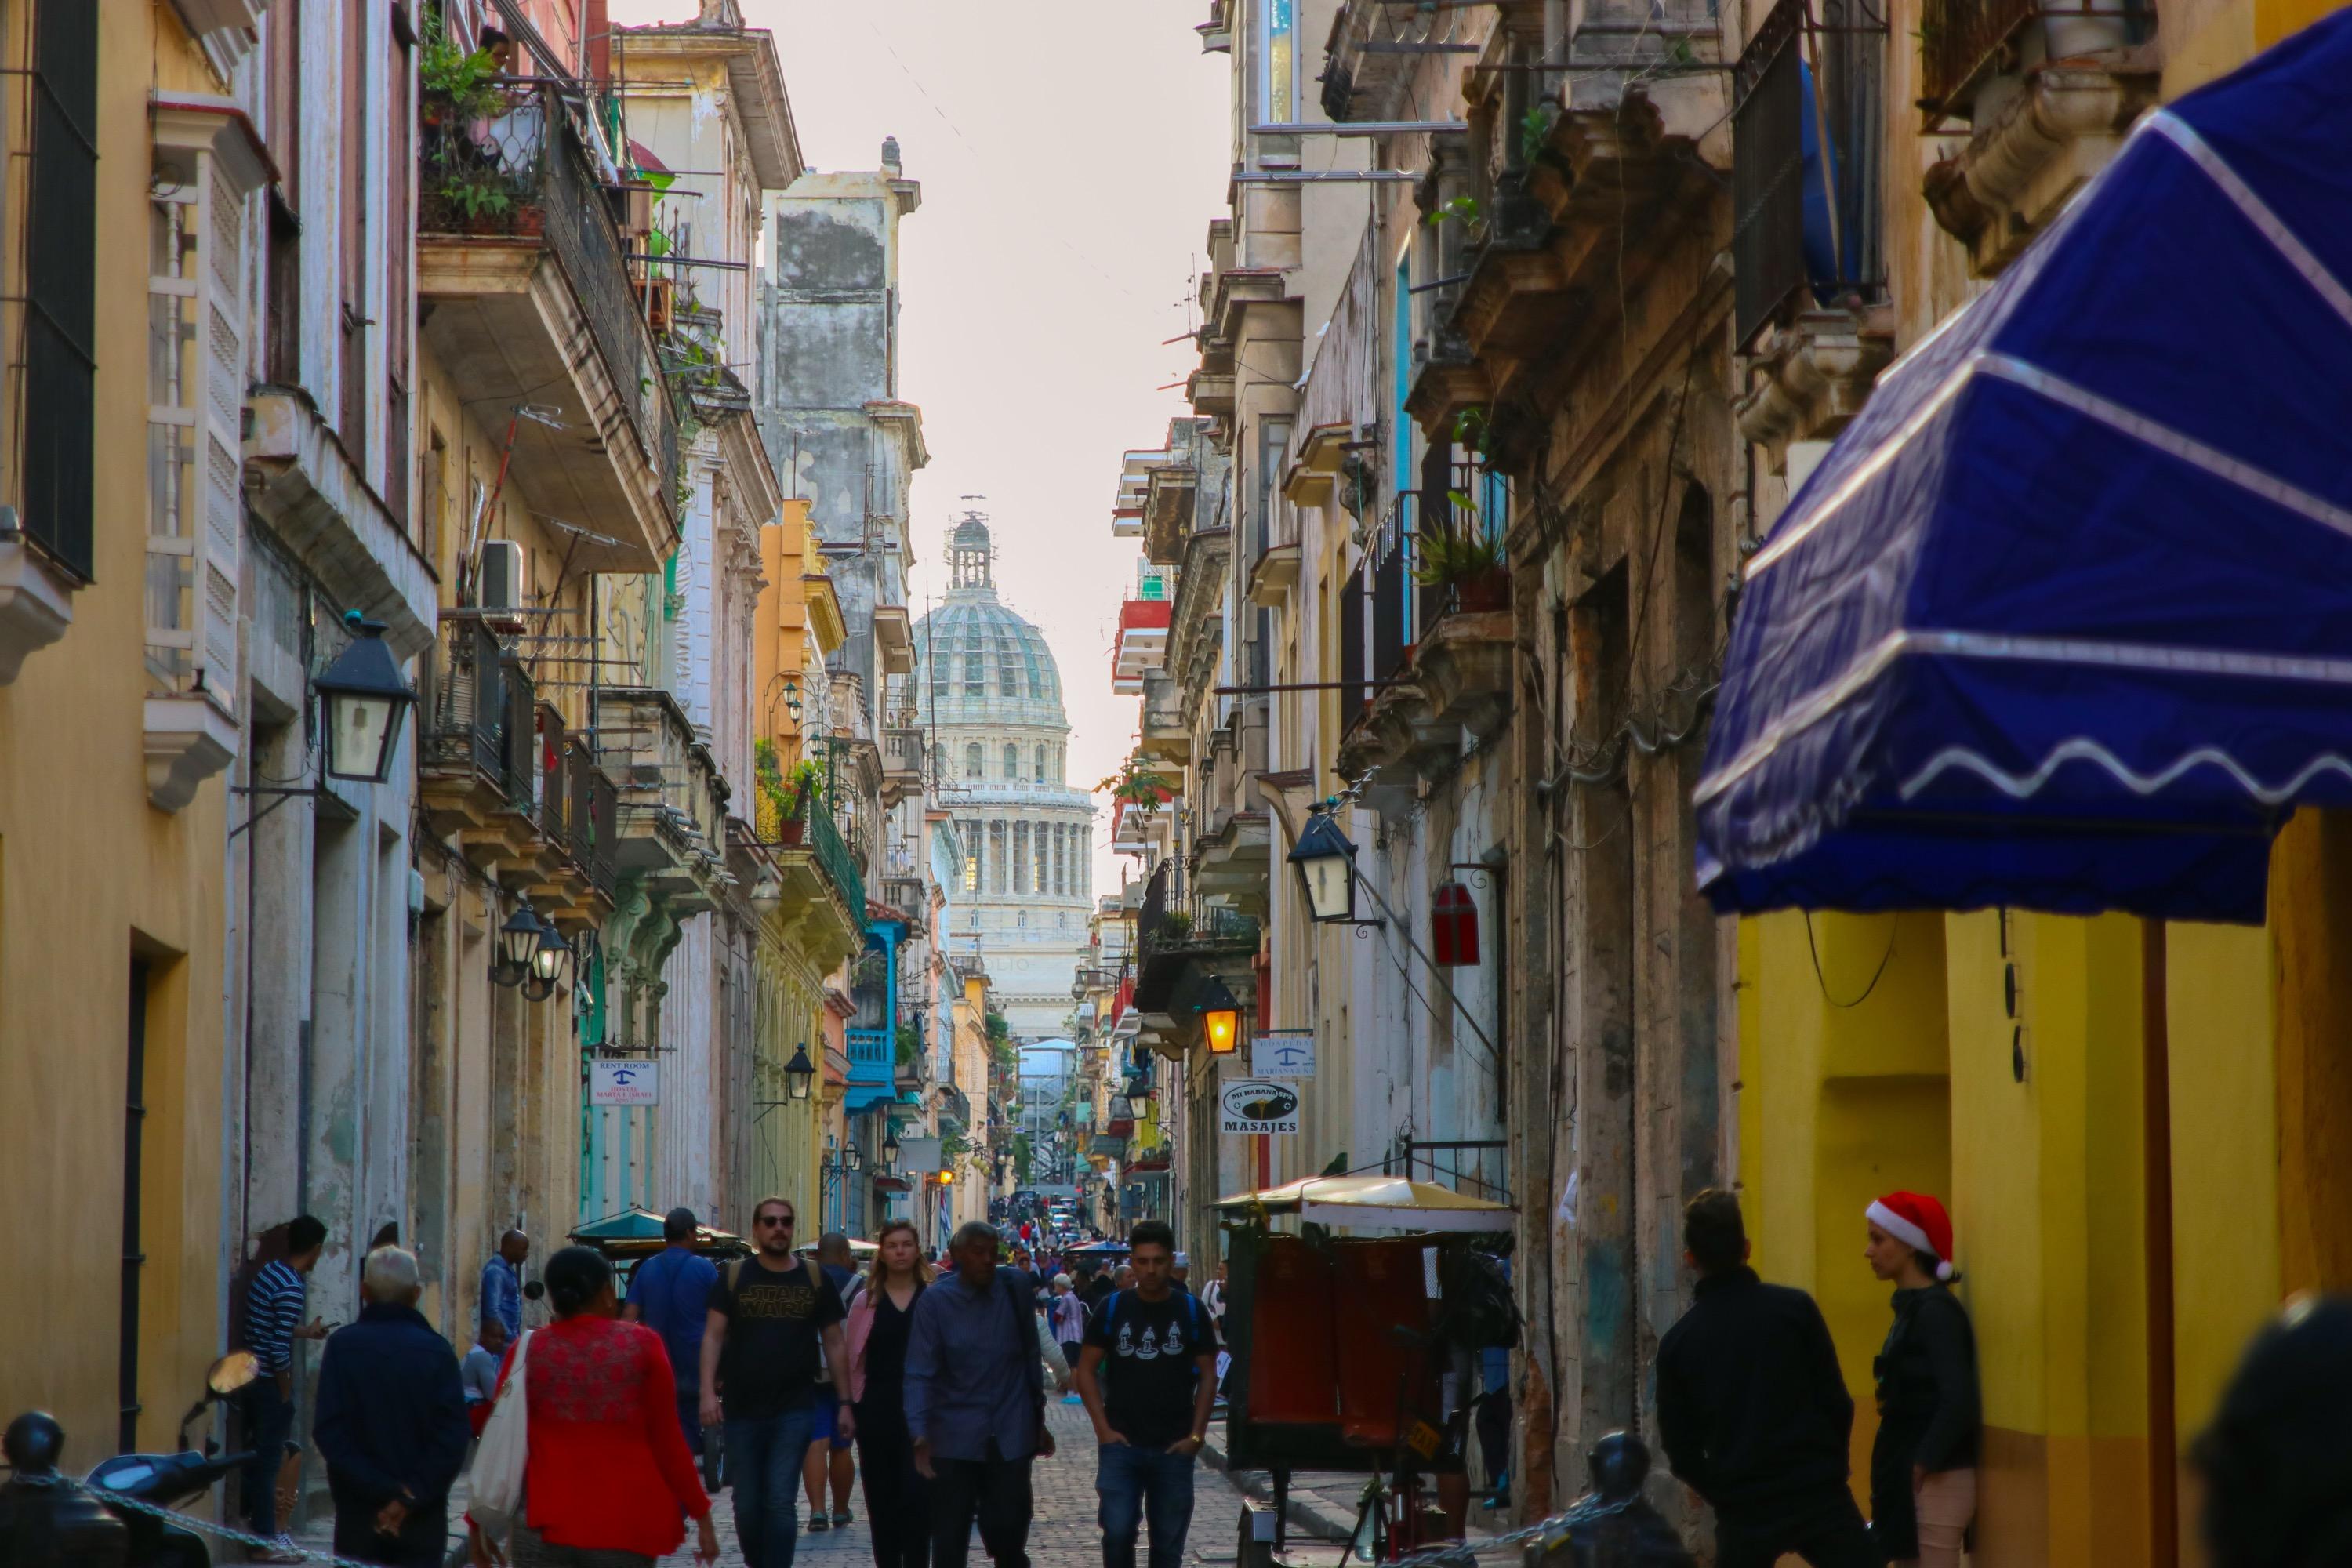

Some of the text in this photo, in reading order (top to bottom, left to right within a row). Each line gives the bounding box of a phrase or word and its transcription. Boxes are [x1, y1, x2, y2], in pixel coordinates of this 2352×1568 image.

[1278, 1091, 1294, 1101] SPA
[1225, 1122, 1297, 1134] MASAJES
[739, 1284, 815, 1301] STAR
[739, 1300, 815, 1319] WARS
